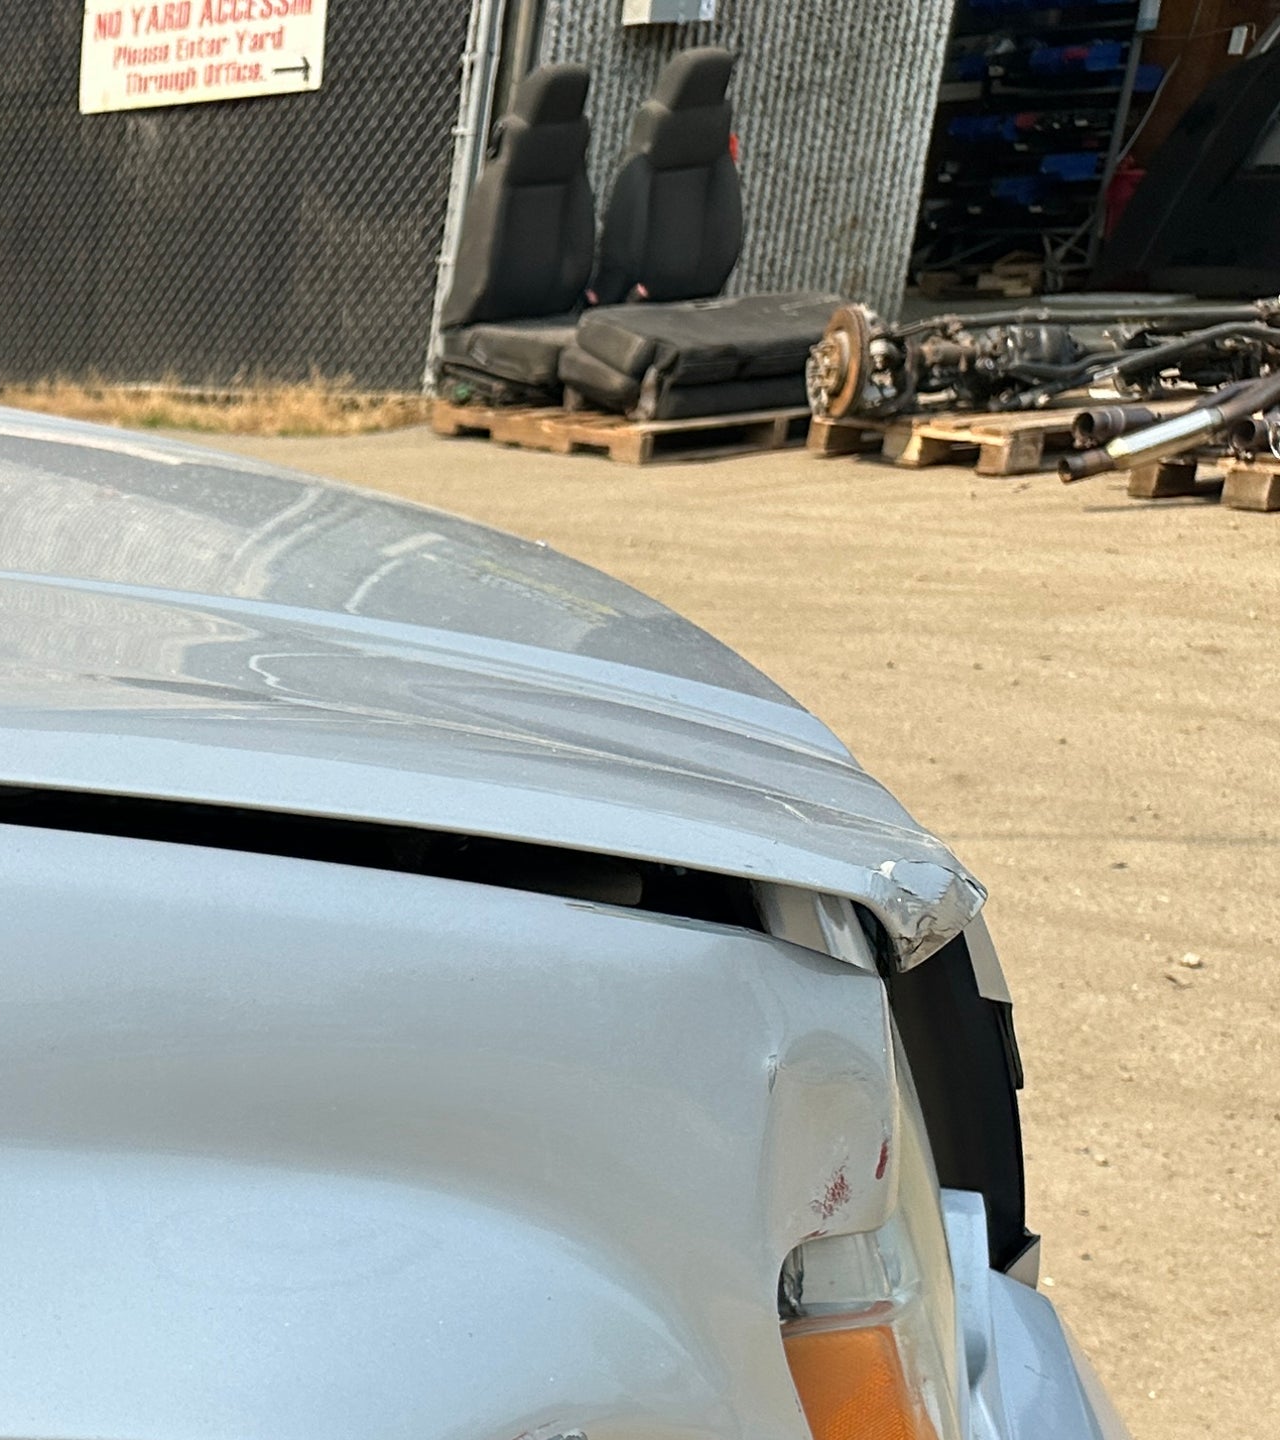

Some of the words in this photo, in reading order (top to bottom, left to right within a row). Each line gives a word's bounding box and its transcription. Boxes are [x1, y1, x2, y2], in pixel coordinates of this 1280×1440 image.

[94, 10, 122, 41] NO
[131, 1, 192, 36] YARD
[113, 43, 170, 69] Please
[176, 36, 229, 63] Enter
[235, 26, 285, 54] Yard
[126, 66, 198, 95] Through
